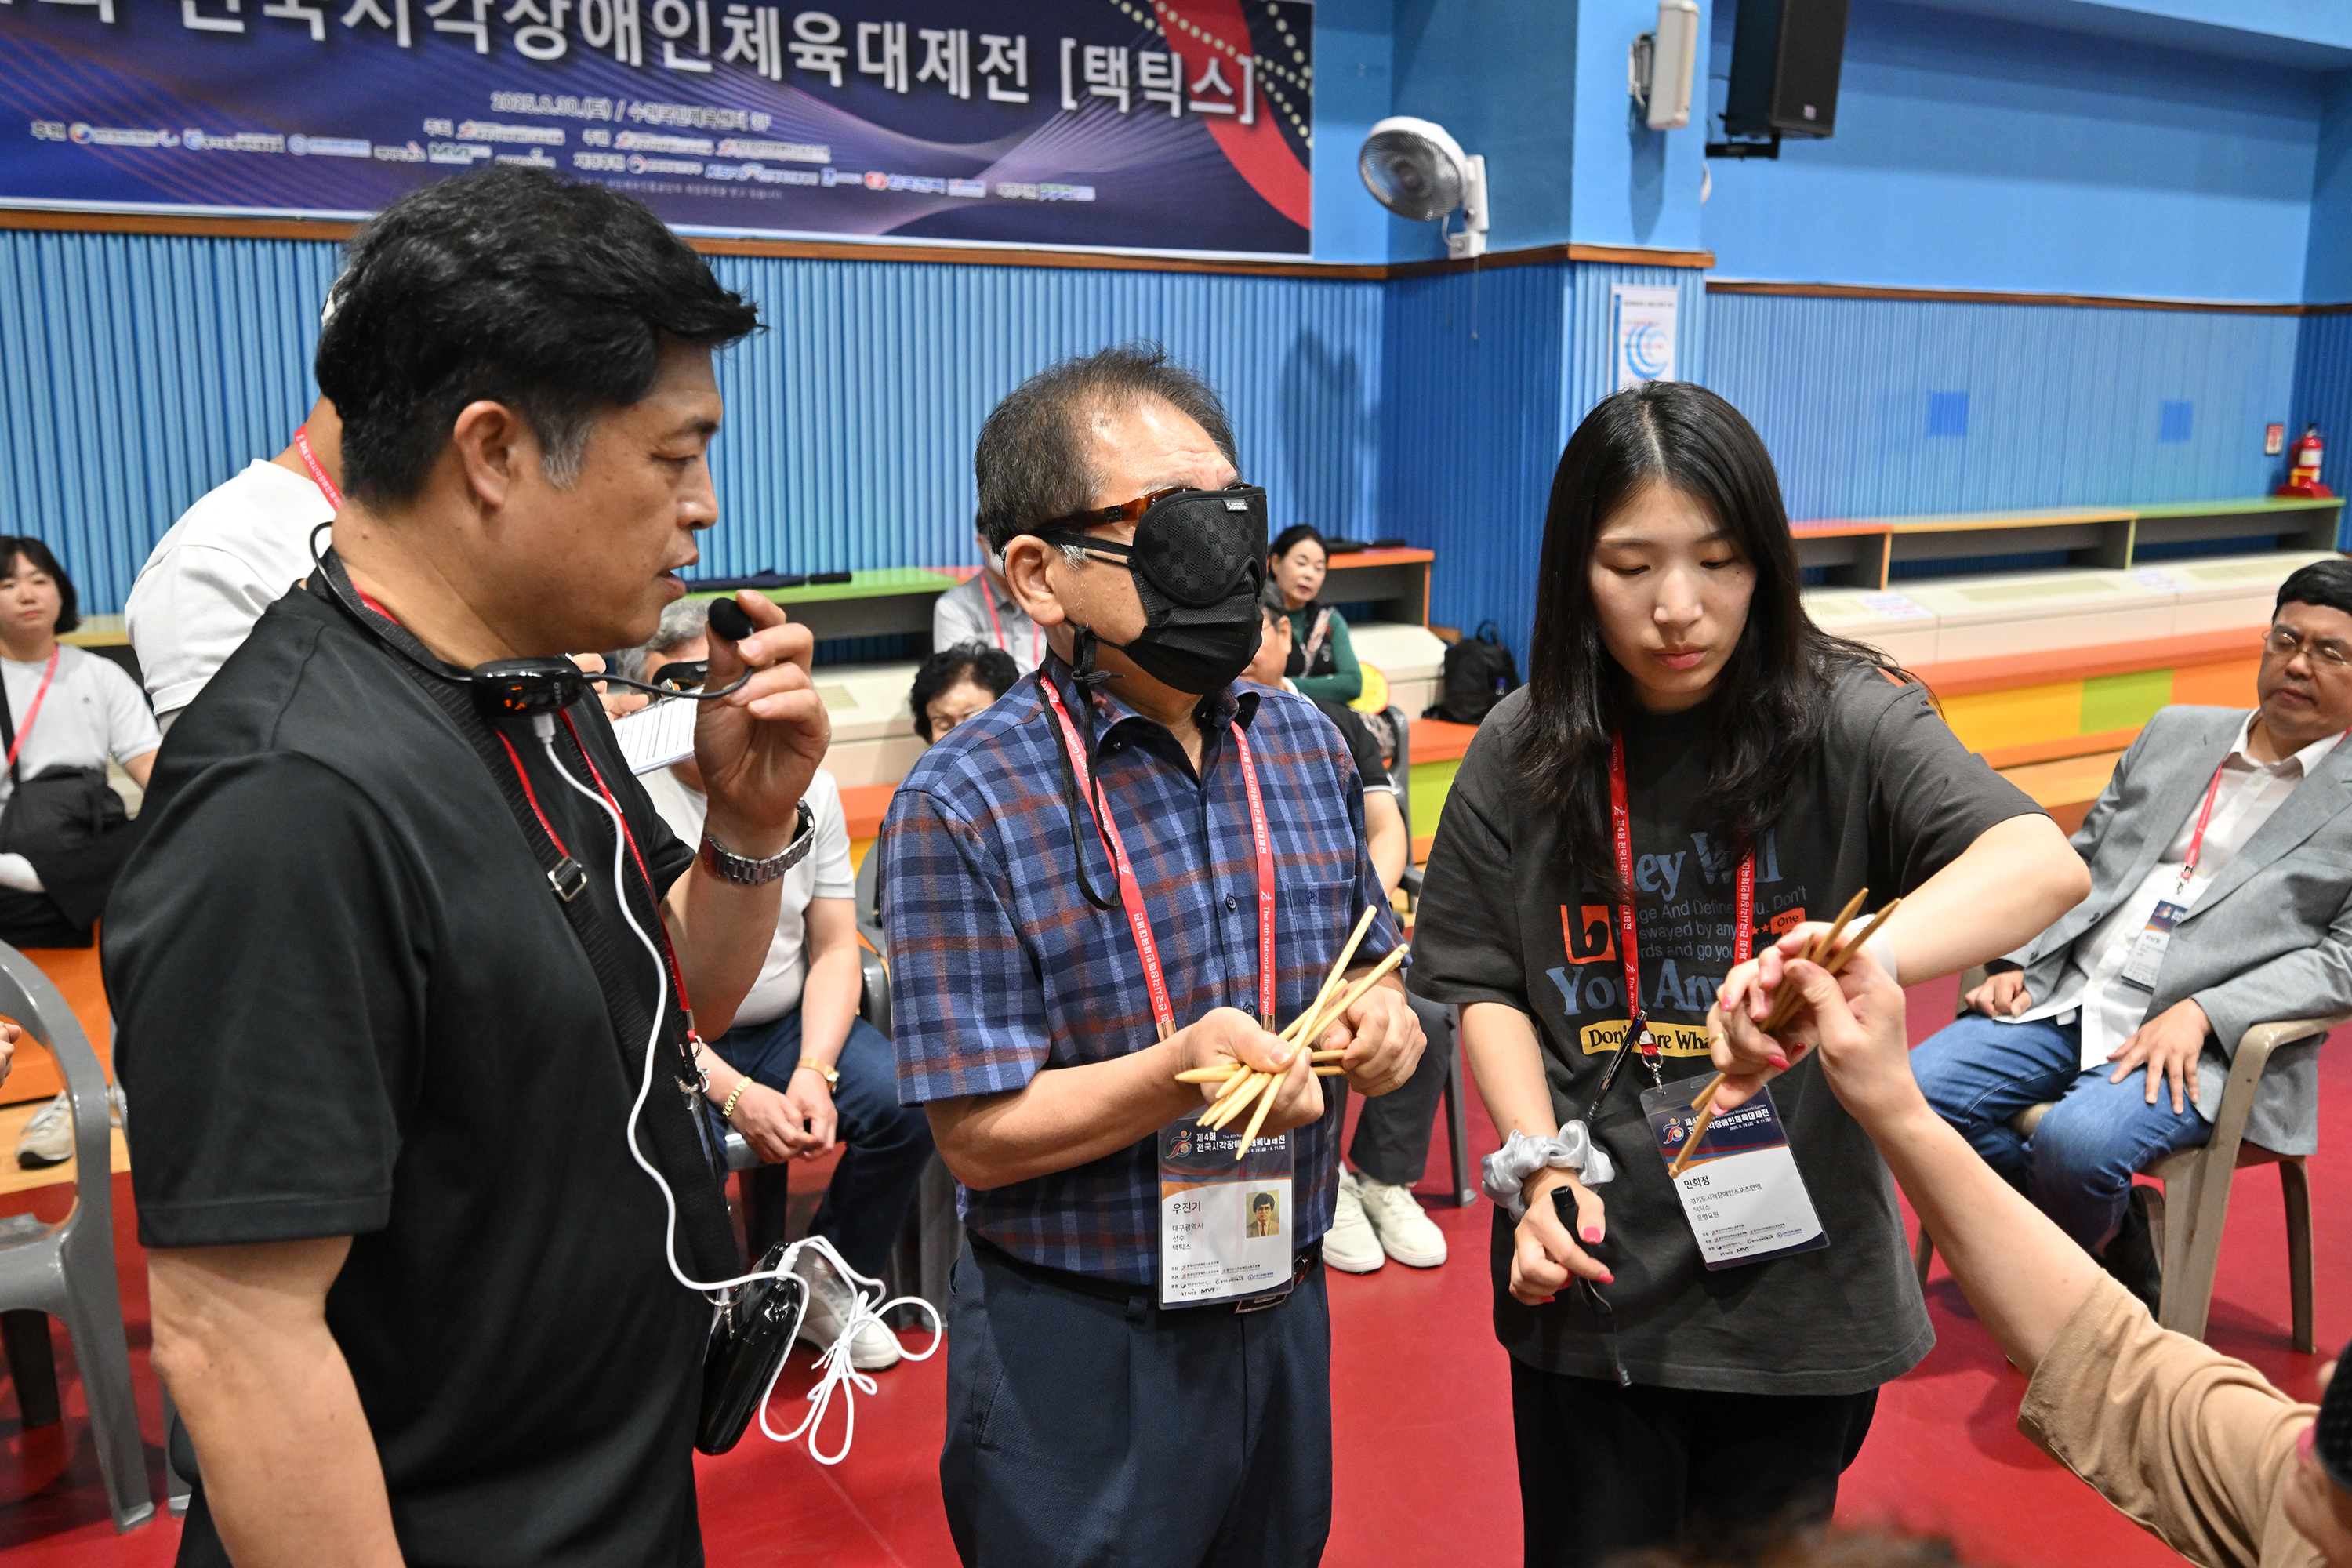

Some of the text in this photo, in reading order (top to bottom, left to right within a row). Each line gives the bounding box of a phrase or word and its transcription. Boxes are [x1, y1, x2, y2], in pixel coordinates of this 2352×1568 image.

[1060, 38, 1255, 123] [택틱스]
[1065, 731, 1080, 753] Games
[1240, 744, 1267, 854] 제4회 전국시각장애인체육대제전
[1617, 820, 1626, 839] 제4회
[1662, 900, 1690, 918] And
[1693, 899, 1735, 915] Define
[1773, 885, 1807, 910] Don't
[1777, 915, 1799, 927] One
[1639, 920, 1693, 942] swayed
[1695, 920, 1712, 939] by
[1667, 941, 1693, 956] and
[1697, 944, 1712, 961] go
[1739, 941, 1748, 960] 제4회
[1134, 913, 1167, 1012] 전국시각장애인체육대제전
[1546, 966, 1647, 1015] You
[1196, 1131, 1217, 1142] 제4회
[1683, 1175, 1711, 1189] 민희정
[1690, 1183, 1762, 1205] 경기도시각장애인스포츠연맹
[1172, 1201, 1201, 1214] 우진기
[1693, 1204, 1711, 1213] 택틱스
[1697, 1211, 1719, 1221] 운영요원
[1172, 1222, 1203, 1232] 대구광역시
